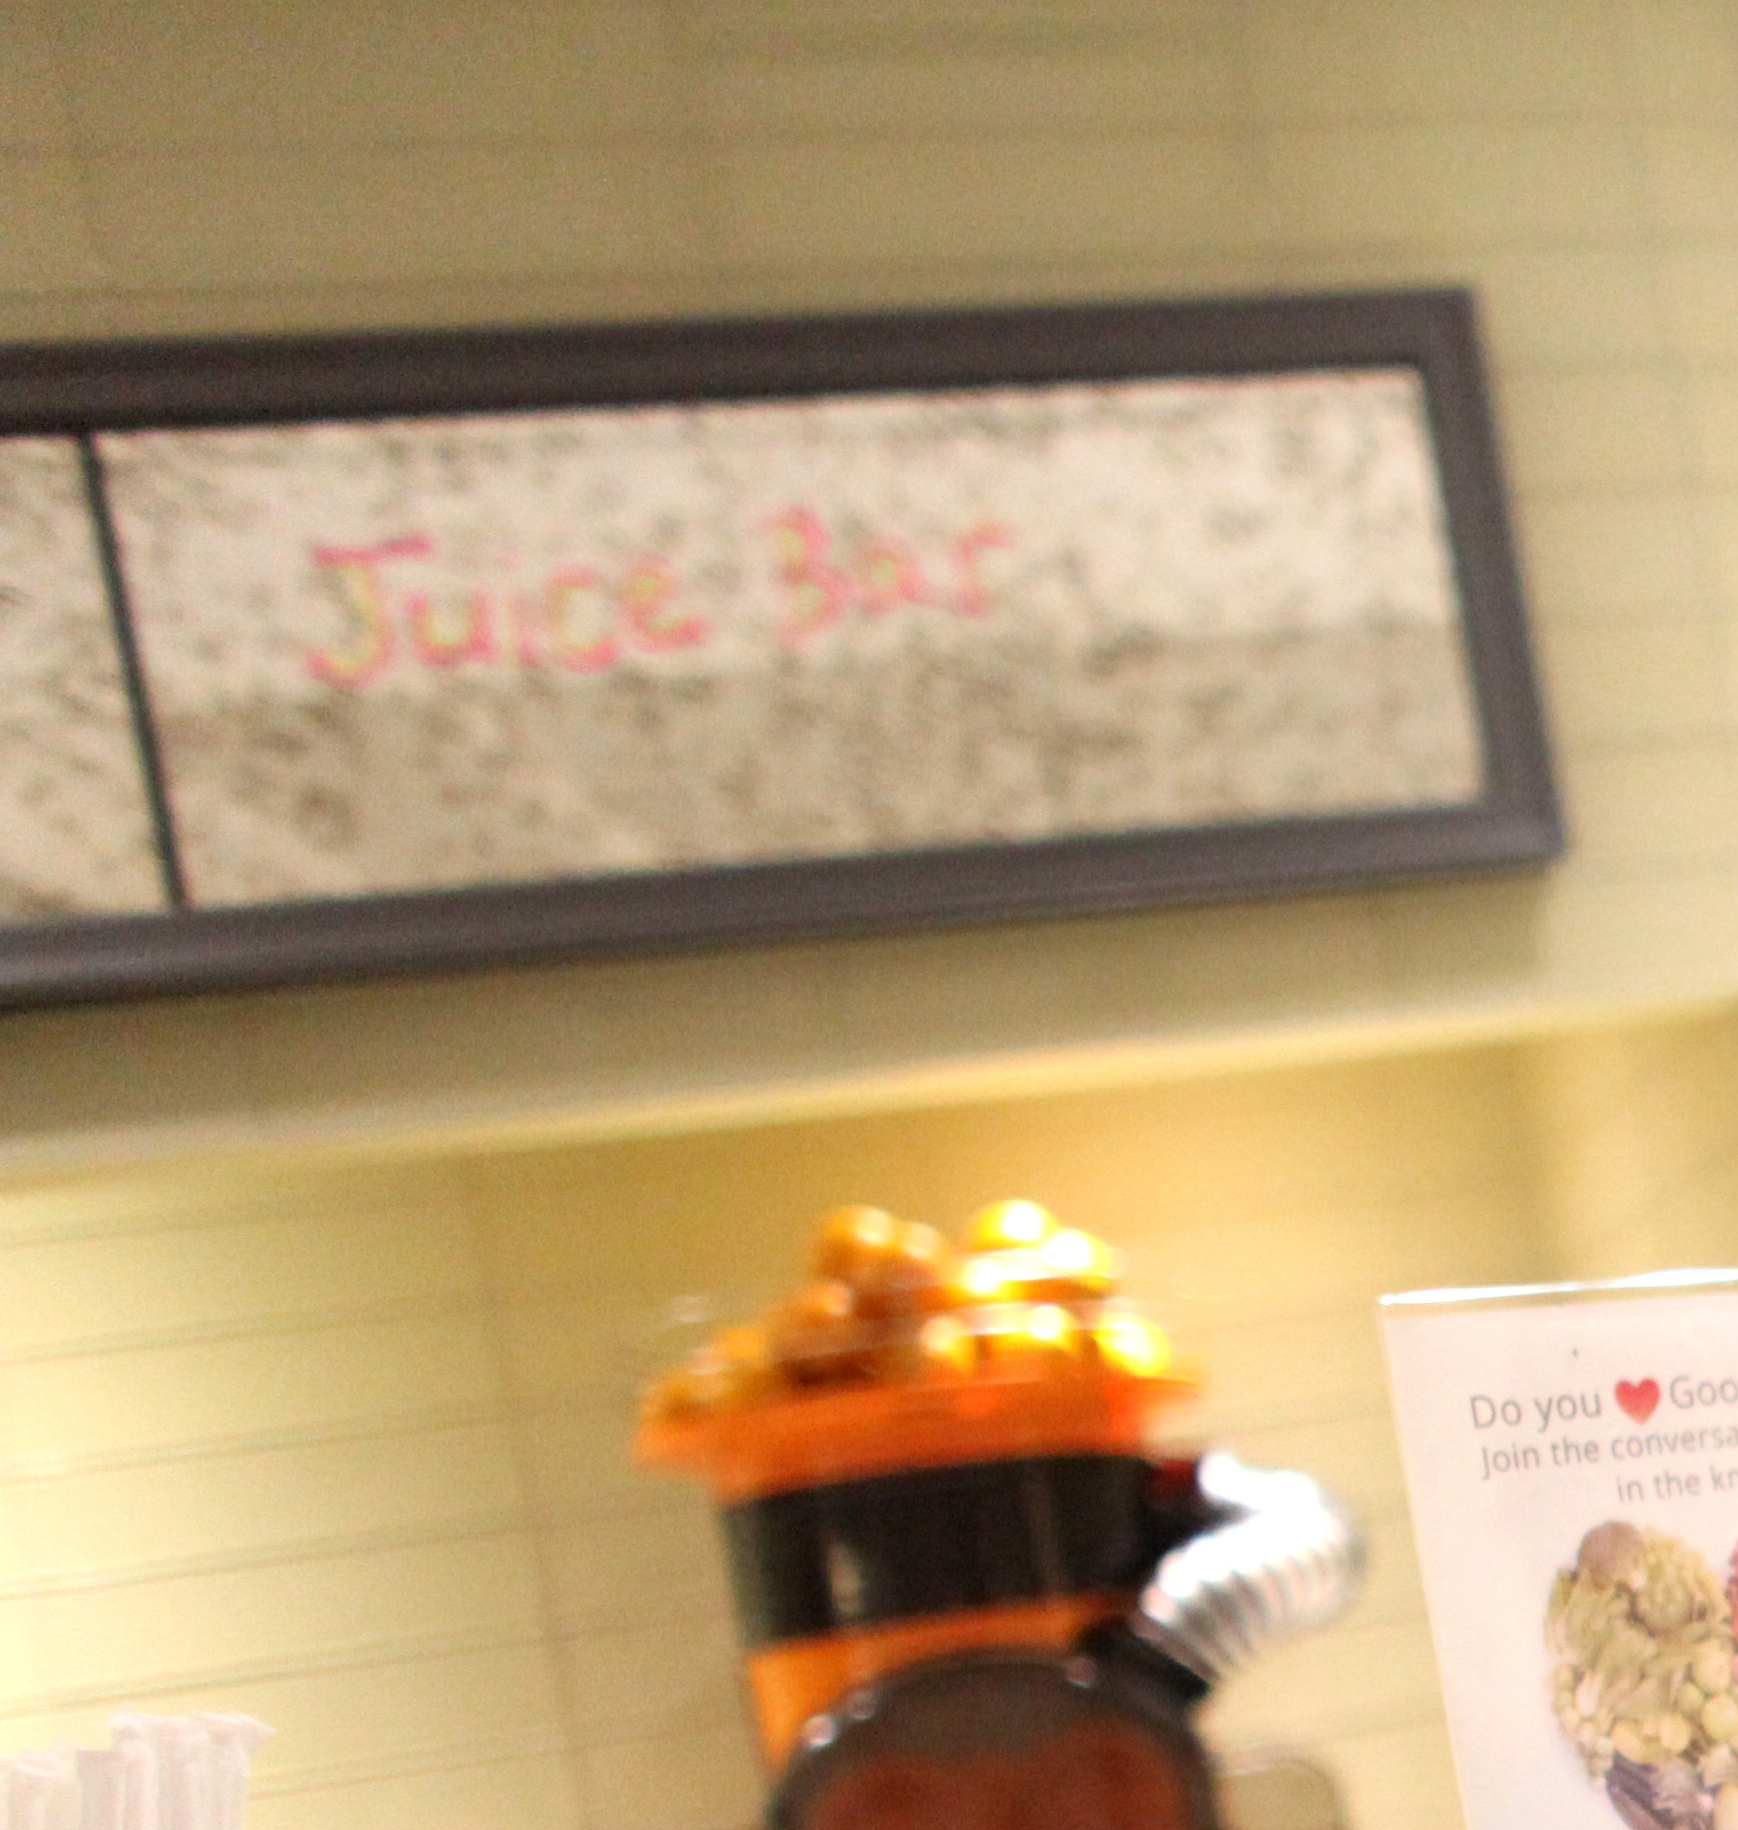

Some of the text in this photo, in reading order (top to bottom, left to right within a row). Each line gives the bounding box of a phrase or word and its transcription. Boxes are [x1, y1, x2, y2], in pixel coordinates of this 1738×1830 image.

[308, 505, 1016, 692] Juice Bar
[1470, 1394, 1523, 1429] Do
[1536, 1392, 1602, 1433] you
[1481, 1445, 1541, 1480] Join
[1551, 1437, 1600, 1467] the
[1616, 1474, 1644, 1503] in
[1653, 1466, 1700, 1498] the
